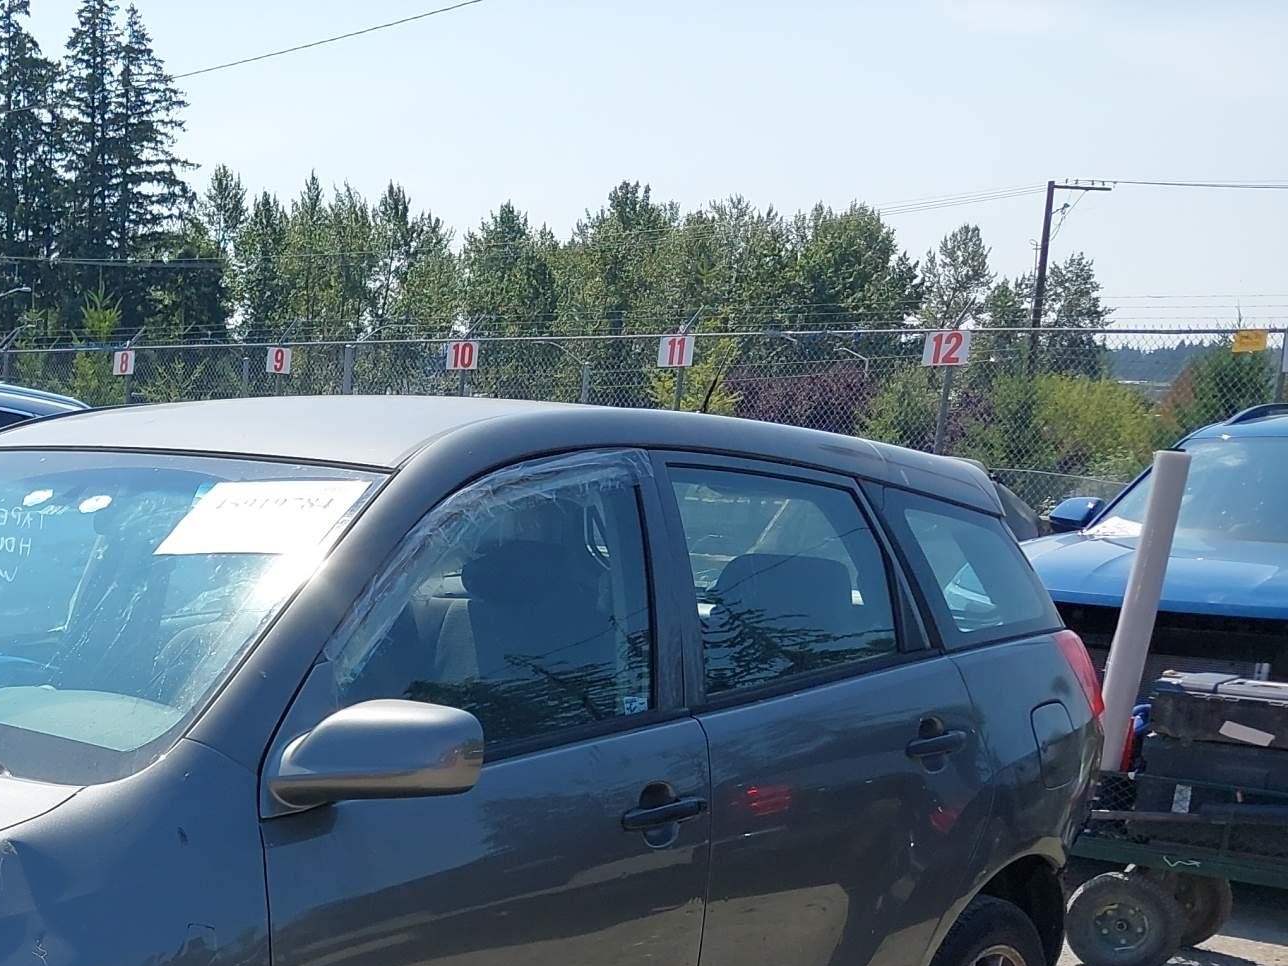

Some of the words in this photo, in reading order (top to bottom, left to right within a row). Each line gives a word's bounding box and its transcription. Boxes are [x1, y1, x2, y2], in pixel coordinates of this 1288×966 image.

[274, 348, 285, 372] 9
[452, 342, 474, 369] 10
[668, 337, 686, 366] 11
[932, 332, 963, 364] 12
[119, 352, 129, 374] 8
